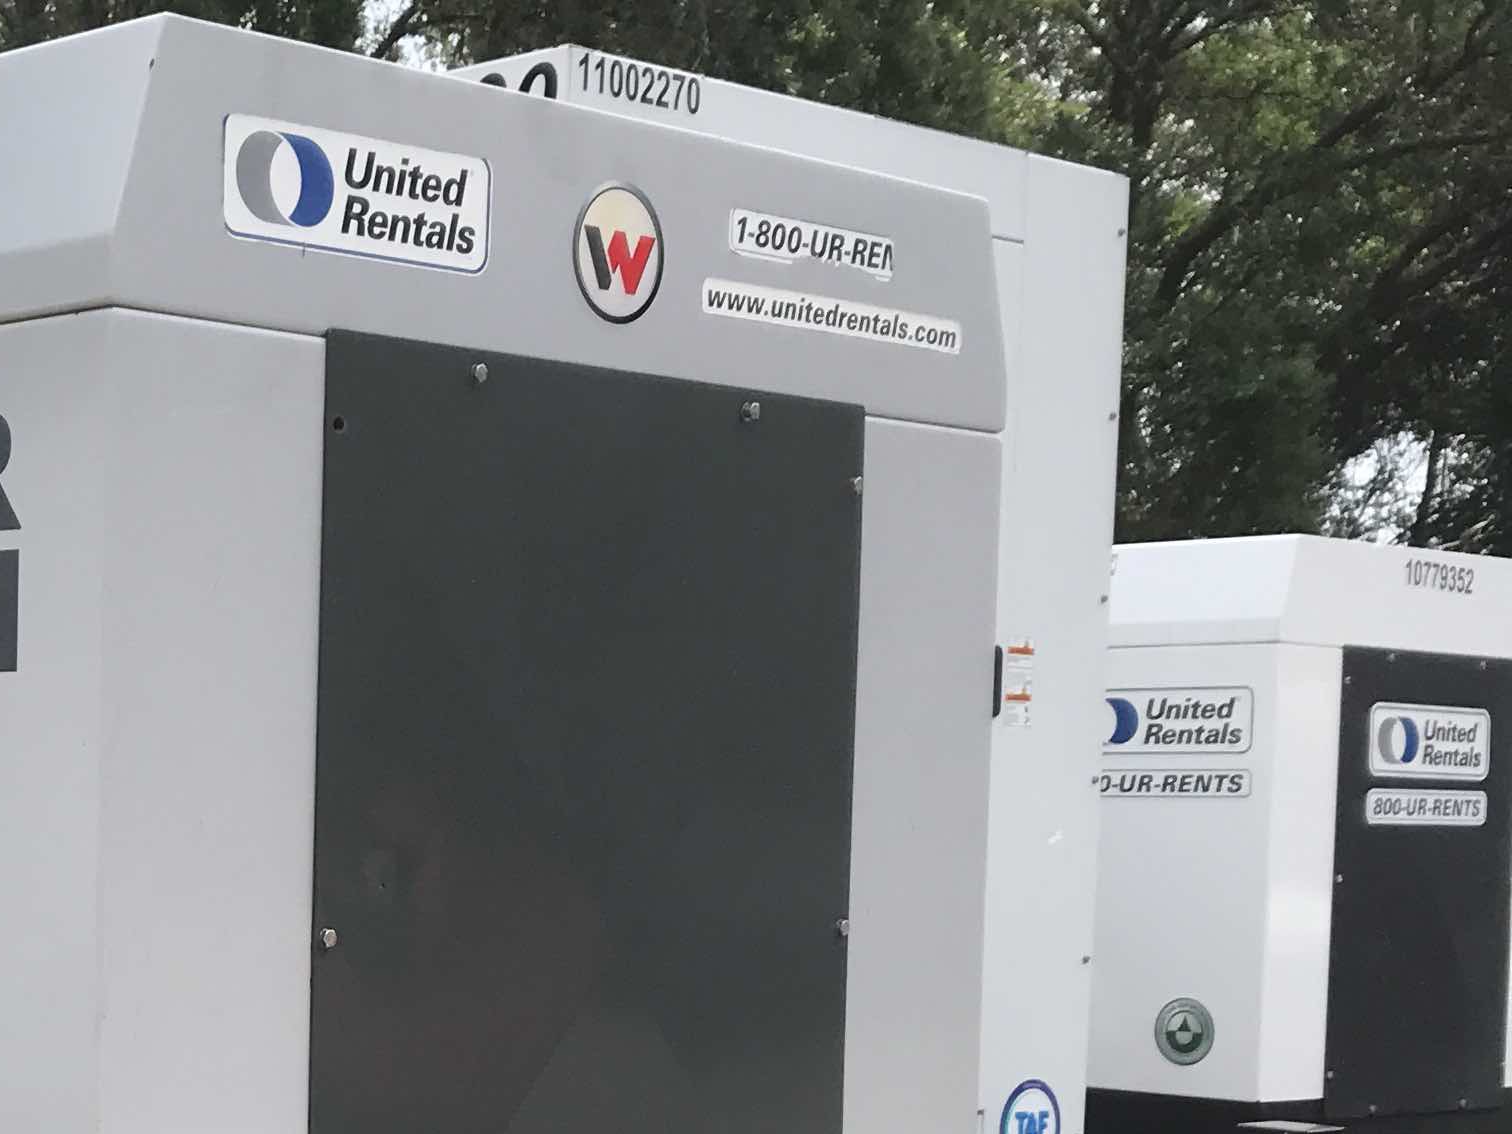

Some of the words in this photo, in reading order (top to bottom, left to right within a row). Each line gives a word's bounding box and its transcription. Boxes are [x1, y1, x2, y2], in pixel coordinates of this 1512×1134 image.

[579, 52, 701, 115] 11002270
[344, 147, 469, 208] United
[341, 194, 476, 255] Rentals
[707, 289, 956, 349] www.unitedrentals.com
[1406, 558, 1475, 594] 10779352
[1145, 697, 1237, 720] United
[1143, 722, 1243, 745] Rentals
[1423, 719, 1478, 743] United
[1421, 744, 1482, 768] Rentals
[1373, 797, 1481, 817] 800-UR-RENTS
